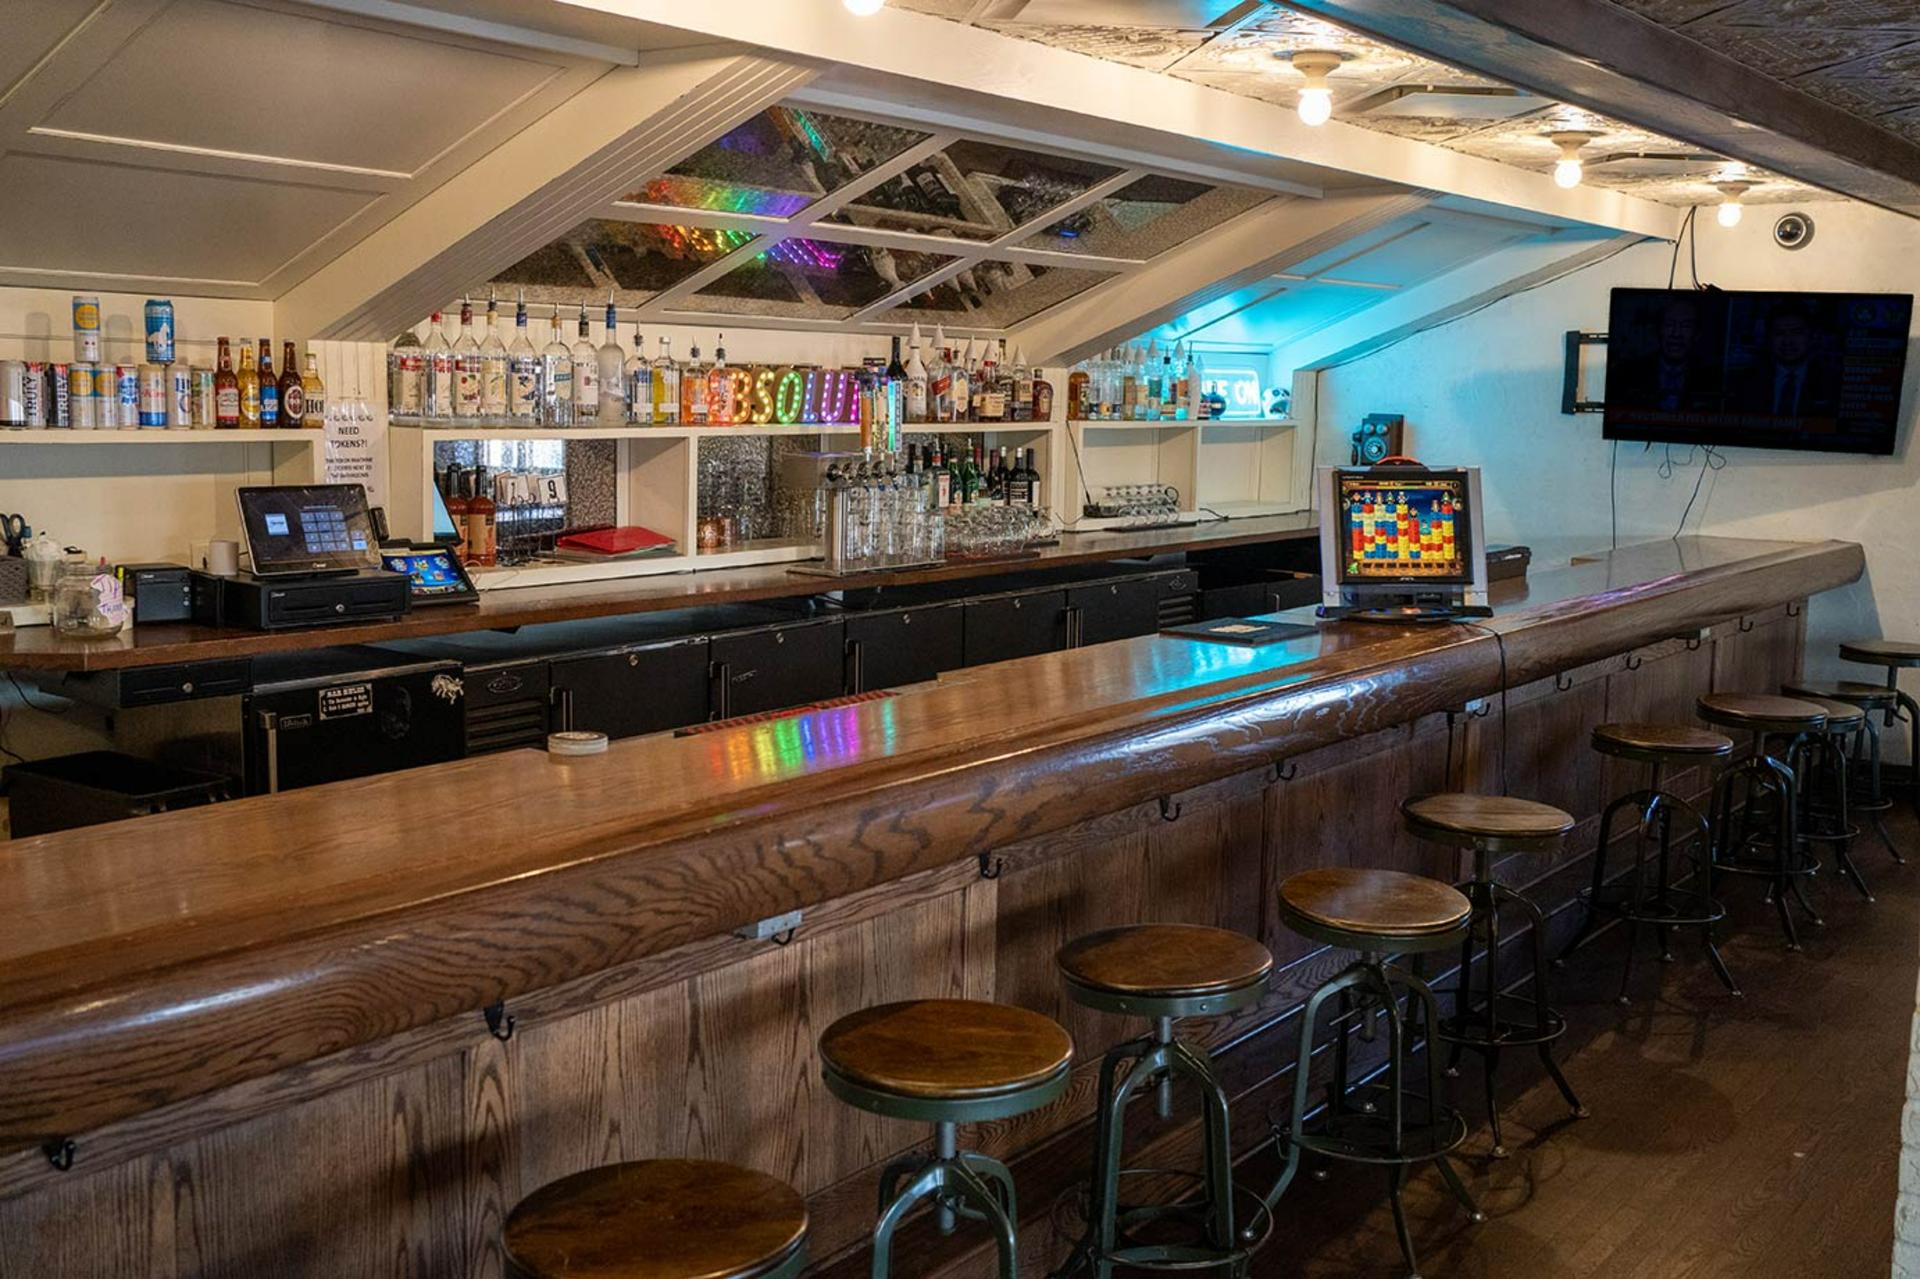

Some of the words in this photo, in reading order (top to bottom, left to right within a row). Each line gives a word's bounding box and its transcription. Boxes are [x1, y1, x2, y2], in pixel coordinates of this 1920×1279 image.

[26, 375, 38, 417] TRULY
[56, 376, 69, 419] TRULY
[338, 426, 360, 435] NEED
[547, 479, 557, 499] 9
